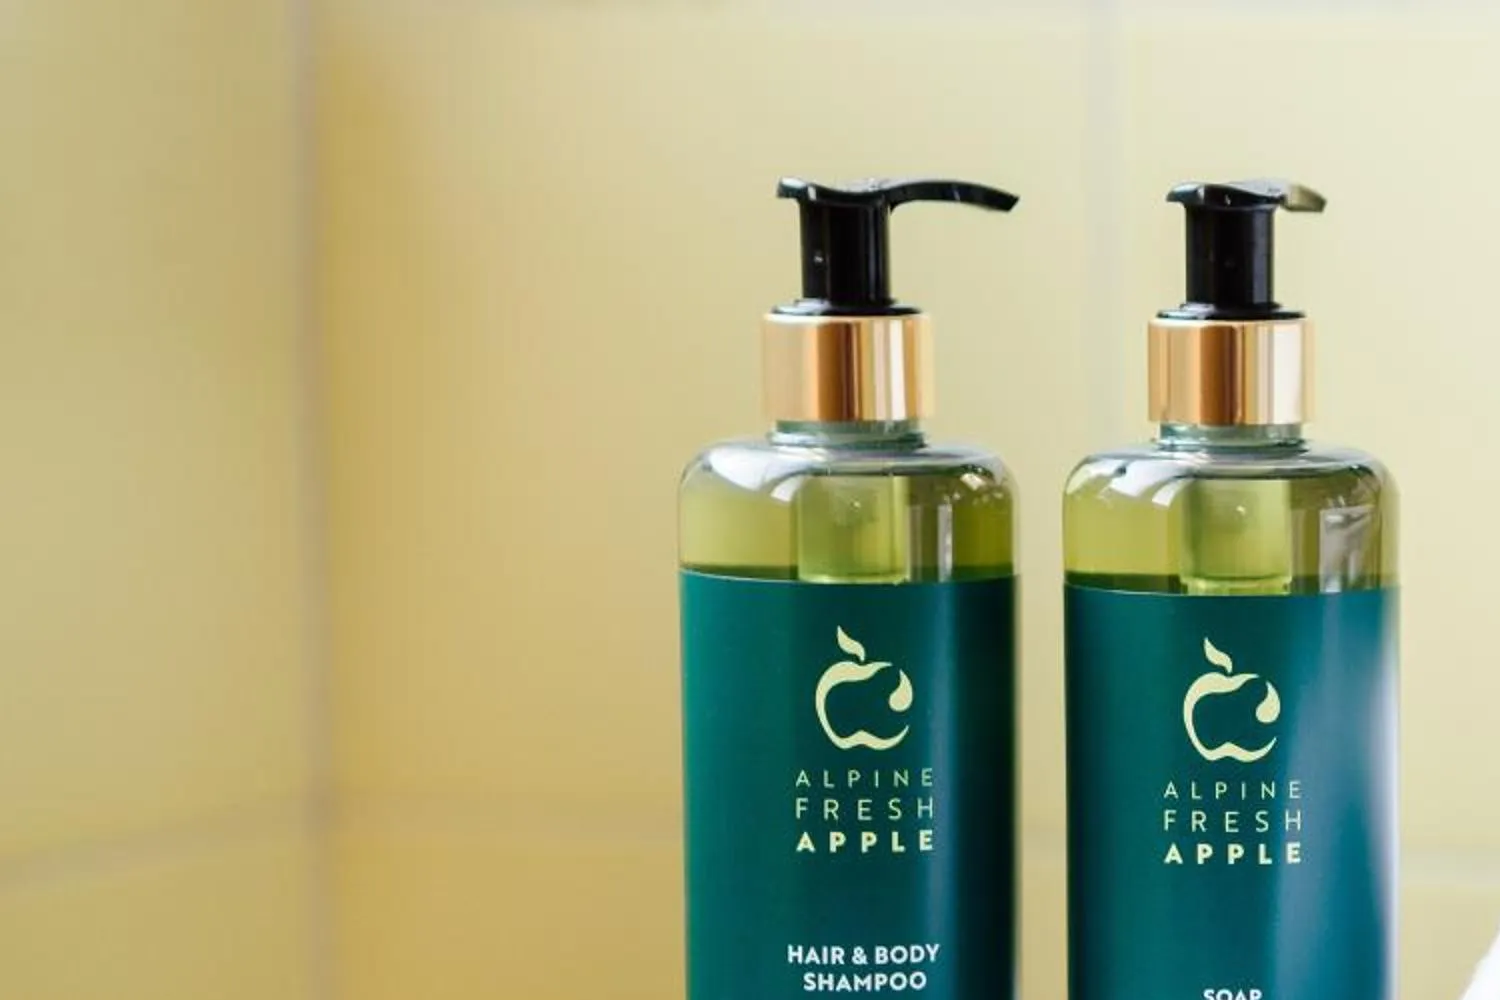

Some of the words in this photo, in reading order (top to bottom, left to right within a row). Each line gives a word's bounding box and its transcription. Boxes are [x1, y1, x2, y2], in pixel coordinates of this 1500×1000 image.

[795, 767, 933, 789] ALPINE
[1163, 780, 1301, 801] ALPINE
[795, 796, 934, 821] FRESH
[1163, 808, 1302, 833] FRESH
[795, 828, 935, 854] APPLE
[1163, 841, 1302, 865] APPLE
[787, 943, 846, 965] HAIR
[851, 945, 869, 966] &
[874, 943, 941, 965] BODY
[803, 970, 928, 993] SHAMPOO
